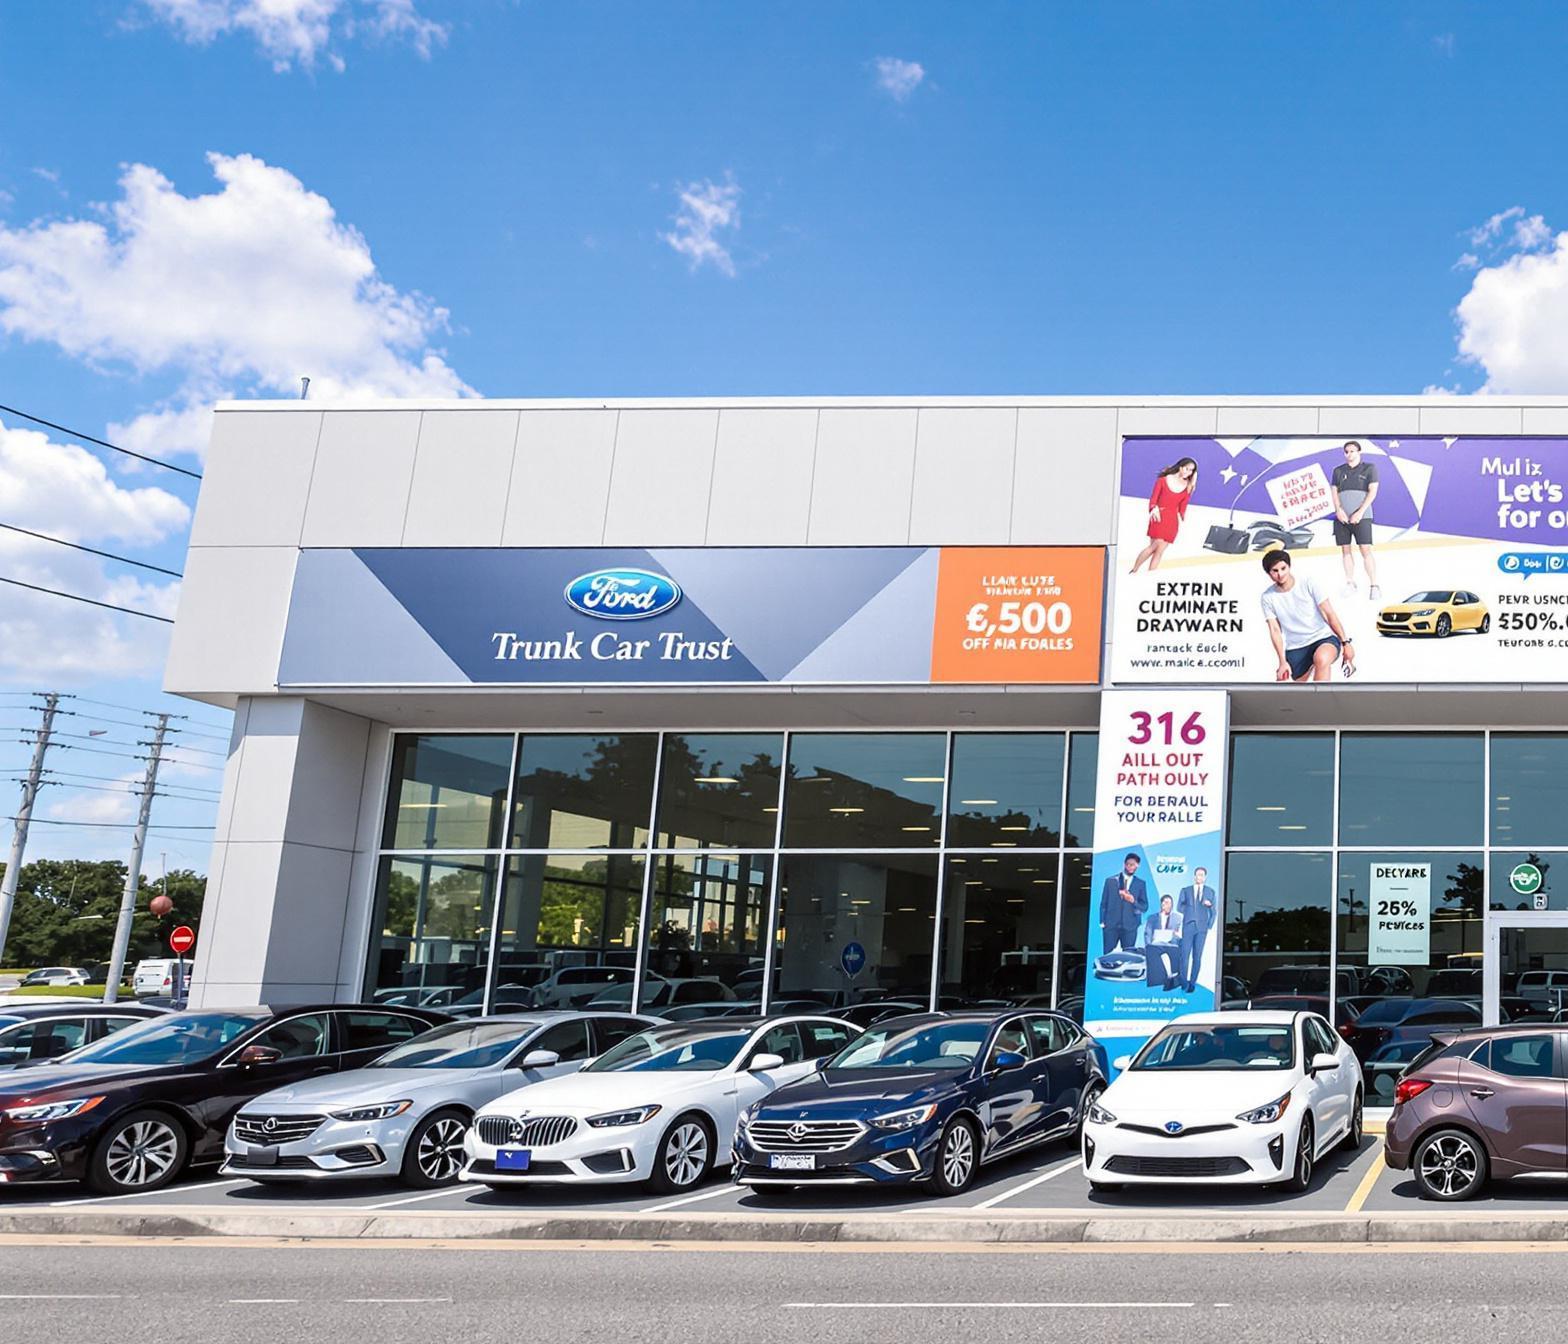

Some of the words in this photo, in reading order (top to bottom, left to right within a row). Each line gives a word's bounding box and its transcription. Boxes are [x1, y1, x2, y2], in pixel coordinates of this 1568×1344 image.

[1498, 478, 1563, 503] Let's
[1497, 503, 1541, 529] for
[583, 576, 658, 609] Ford
[1157, 582, 1223, 597] EXTRIN
[1136, 618, 1243, 632] DRAYWARN
[492, 632, 582, 660] Trunk
[591, 632, 650, 660] Car
[659, 632, 733, 660] Trust
[962, 638, 990, 650] OFF
[1128, 711, 1206, 745] 316
[1122, 753, 1160, 766] AILL
[1166, 753, 1203, 766] OUT
[1116, 773, 1159, 785] PATH
[1164, 773, 1208, 785] OULY
[1114, 796, 1142, 806] FOR
[1117, 811, 1155, 822] YOUR
[1158, 811, 1203, 822] RALLE
